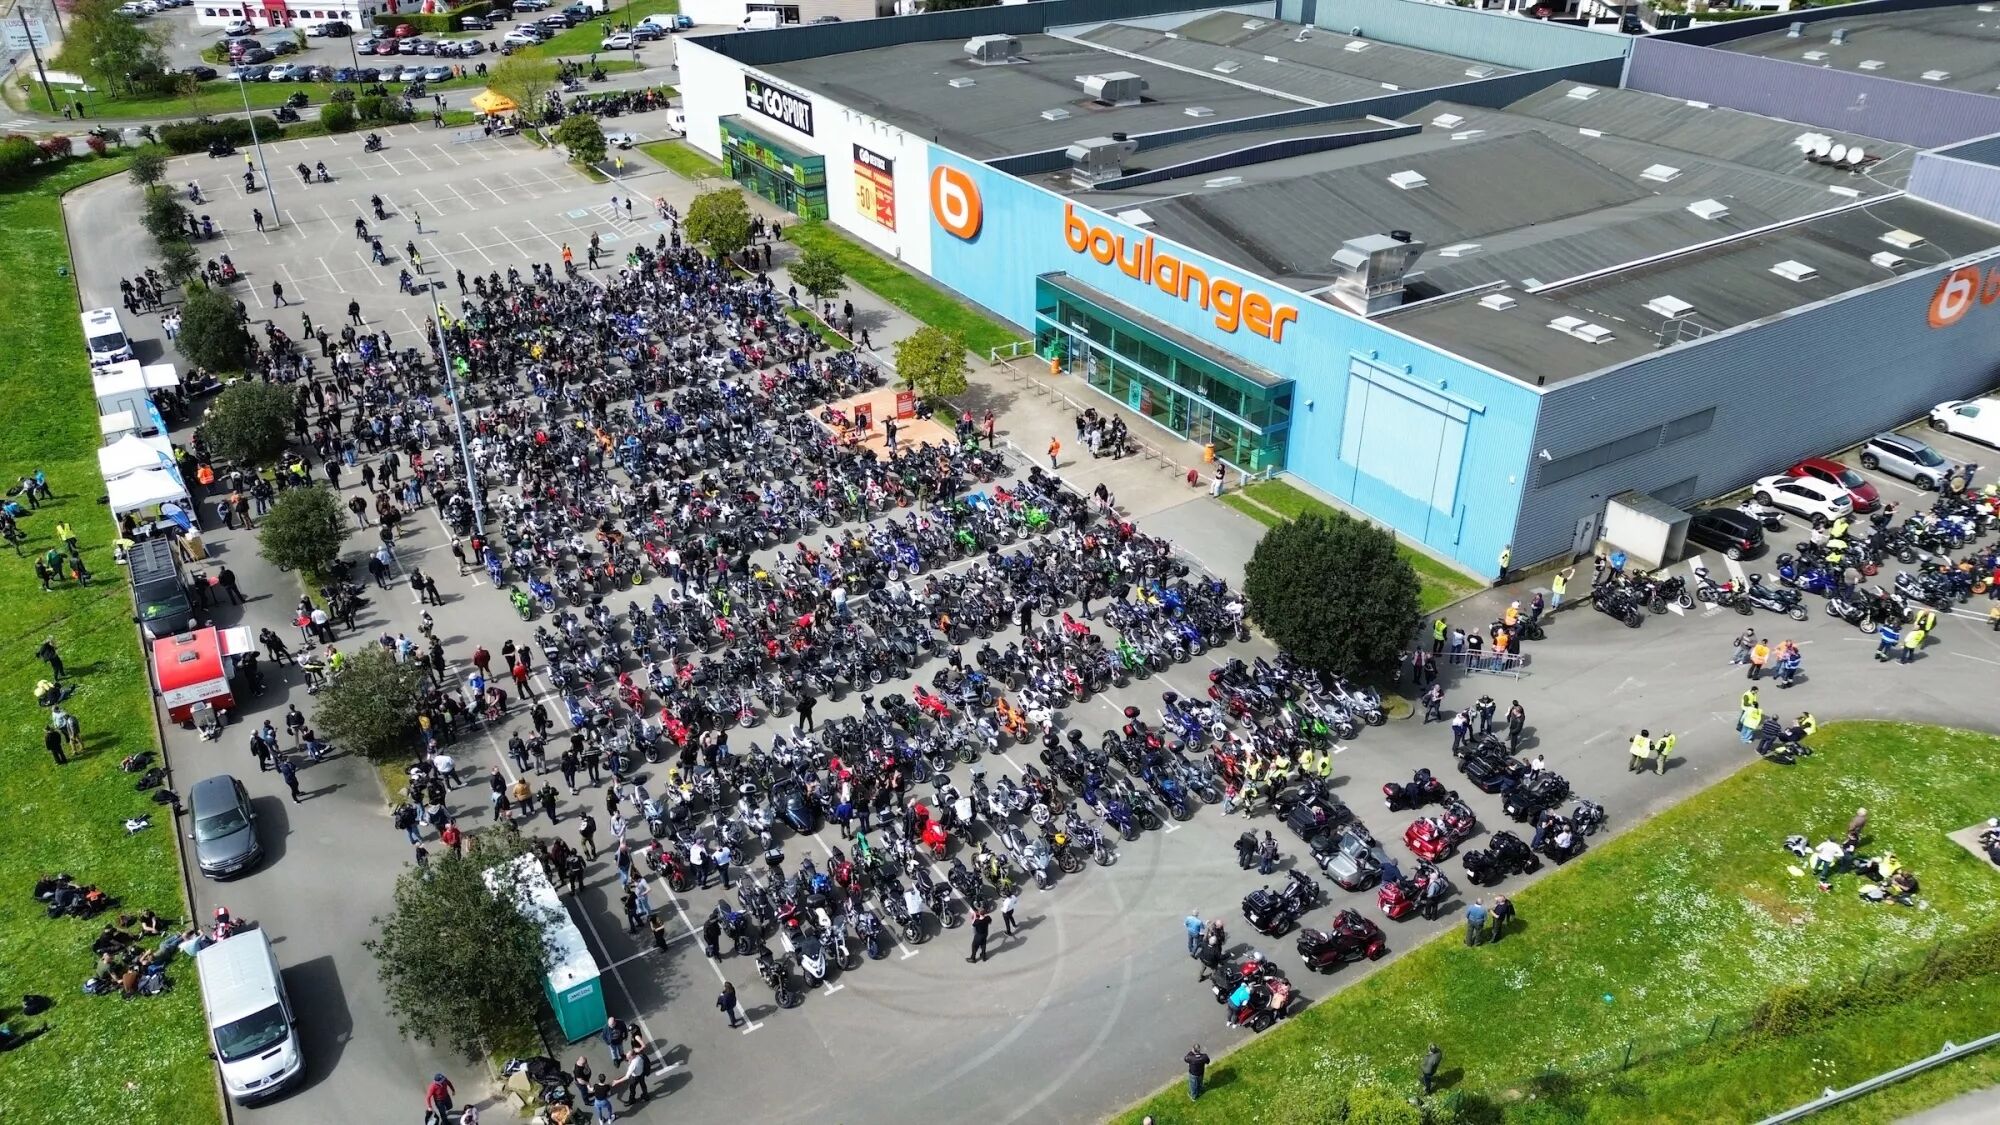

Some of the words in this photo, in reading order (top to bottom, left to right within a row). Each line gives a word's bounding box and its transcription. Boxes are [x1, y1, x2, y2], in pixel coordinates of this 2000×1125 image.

[764, 87, 783, 119] GO
[782, 94, 810, 132] SPORT
[1064, 201, 1299, 343] boulanger
